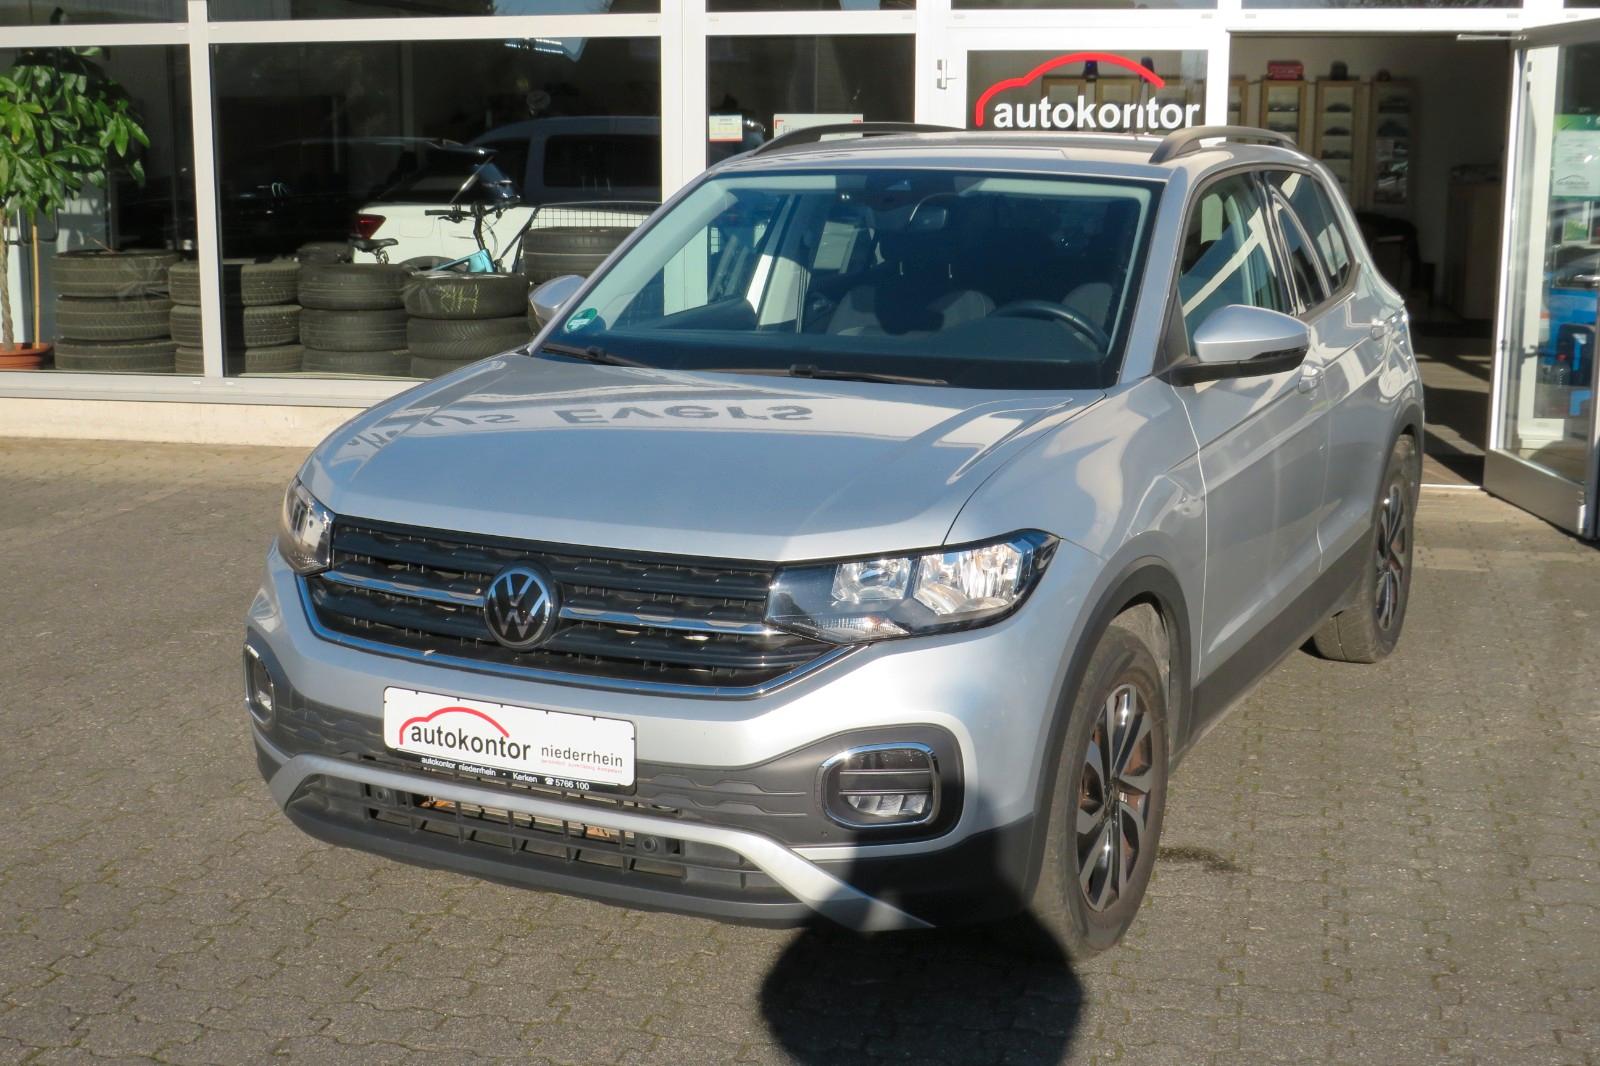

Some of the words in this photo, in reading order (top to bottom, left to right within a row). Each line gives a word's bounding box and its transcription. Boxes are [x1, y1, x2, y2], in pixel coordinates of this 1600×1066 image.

[993, 95, 1201, 129] autokontor
[410, 725, 532, 761] autokontor
[541, 744, 623, 768] niederrhein
[421, 757, 456, 769] autokontor
[512, 772, 538, 783] Kerken
[575, 781, 590, 790] 100
